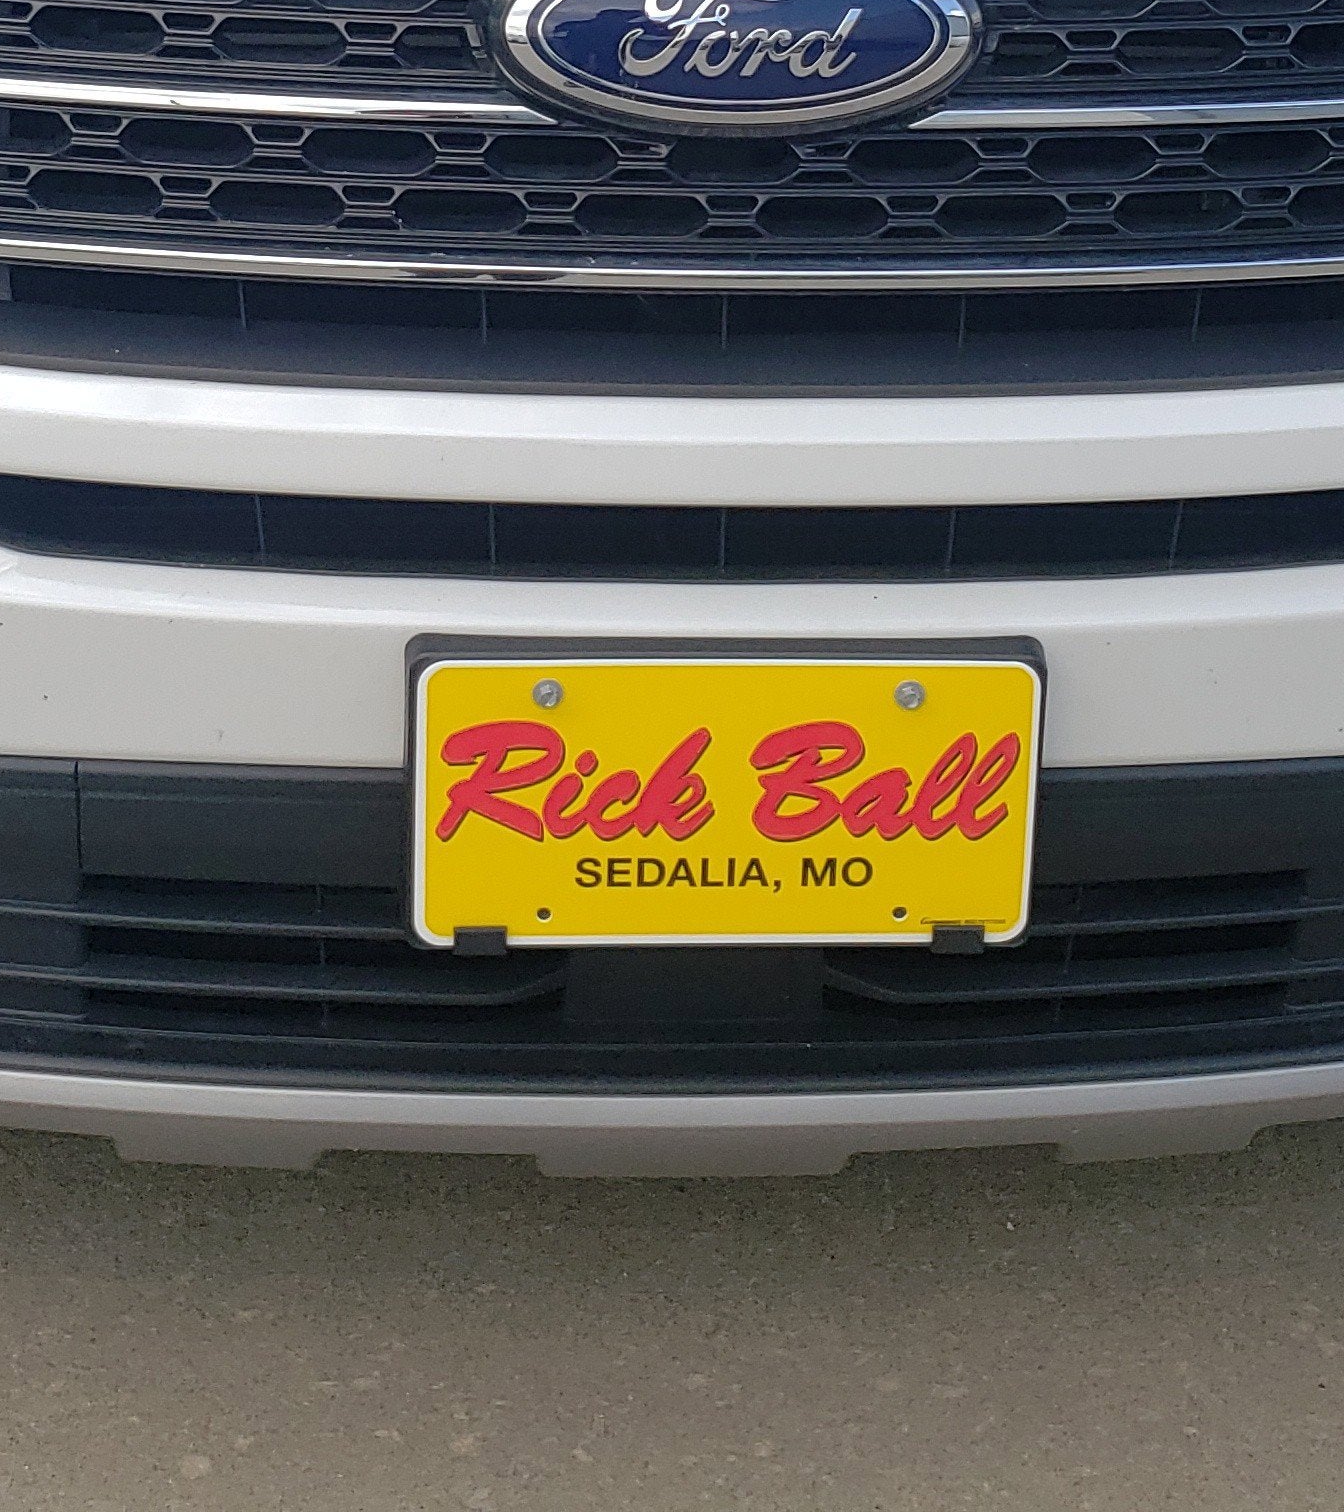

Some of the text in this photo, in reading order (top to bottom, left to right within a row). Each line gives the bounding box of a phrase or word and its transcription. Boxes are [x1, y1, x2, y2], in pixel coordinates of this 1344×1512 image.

[436, 720, 1020, 842] Rick Ball
[574, 857, 874, 892] SEDALIA, MO
